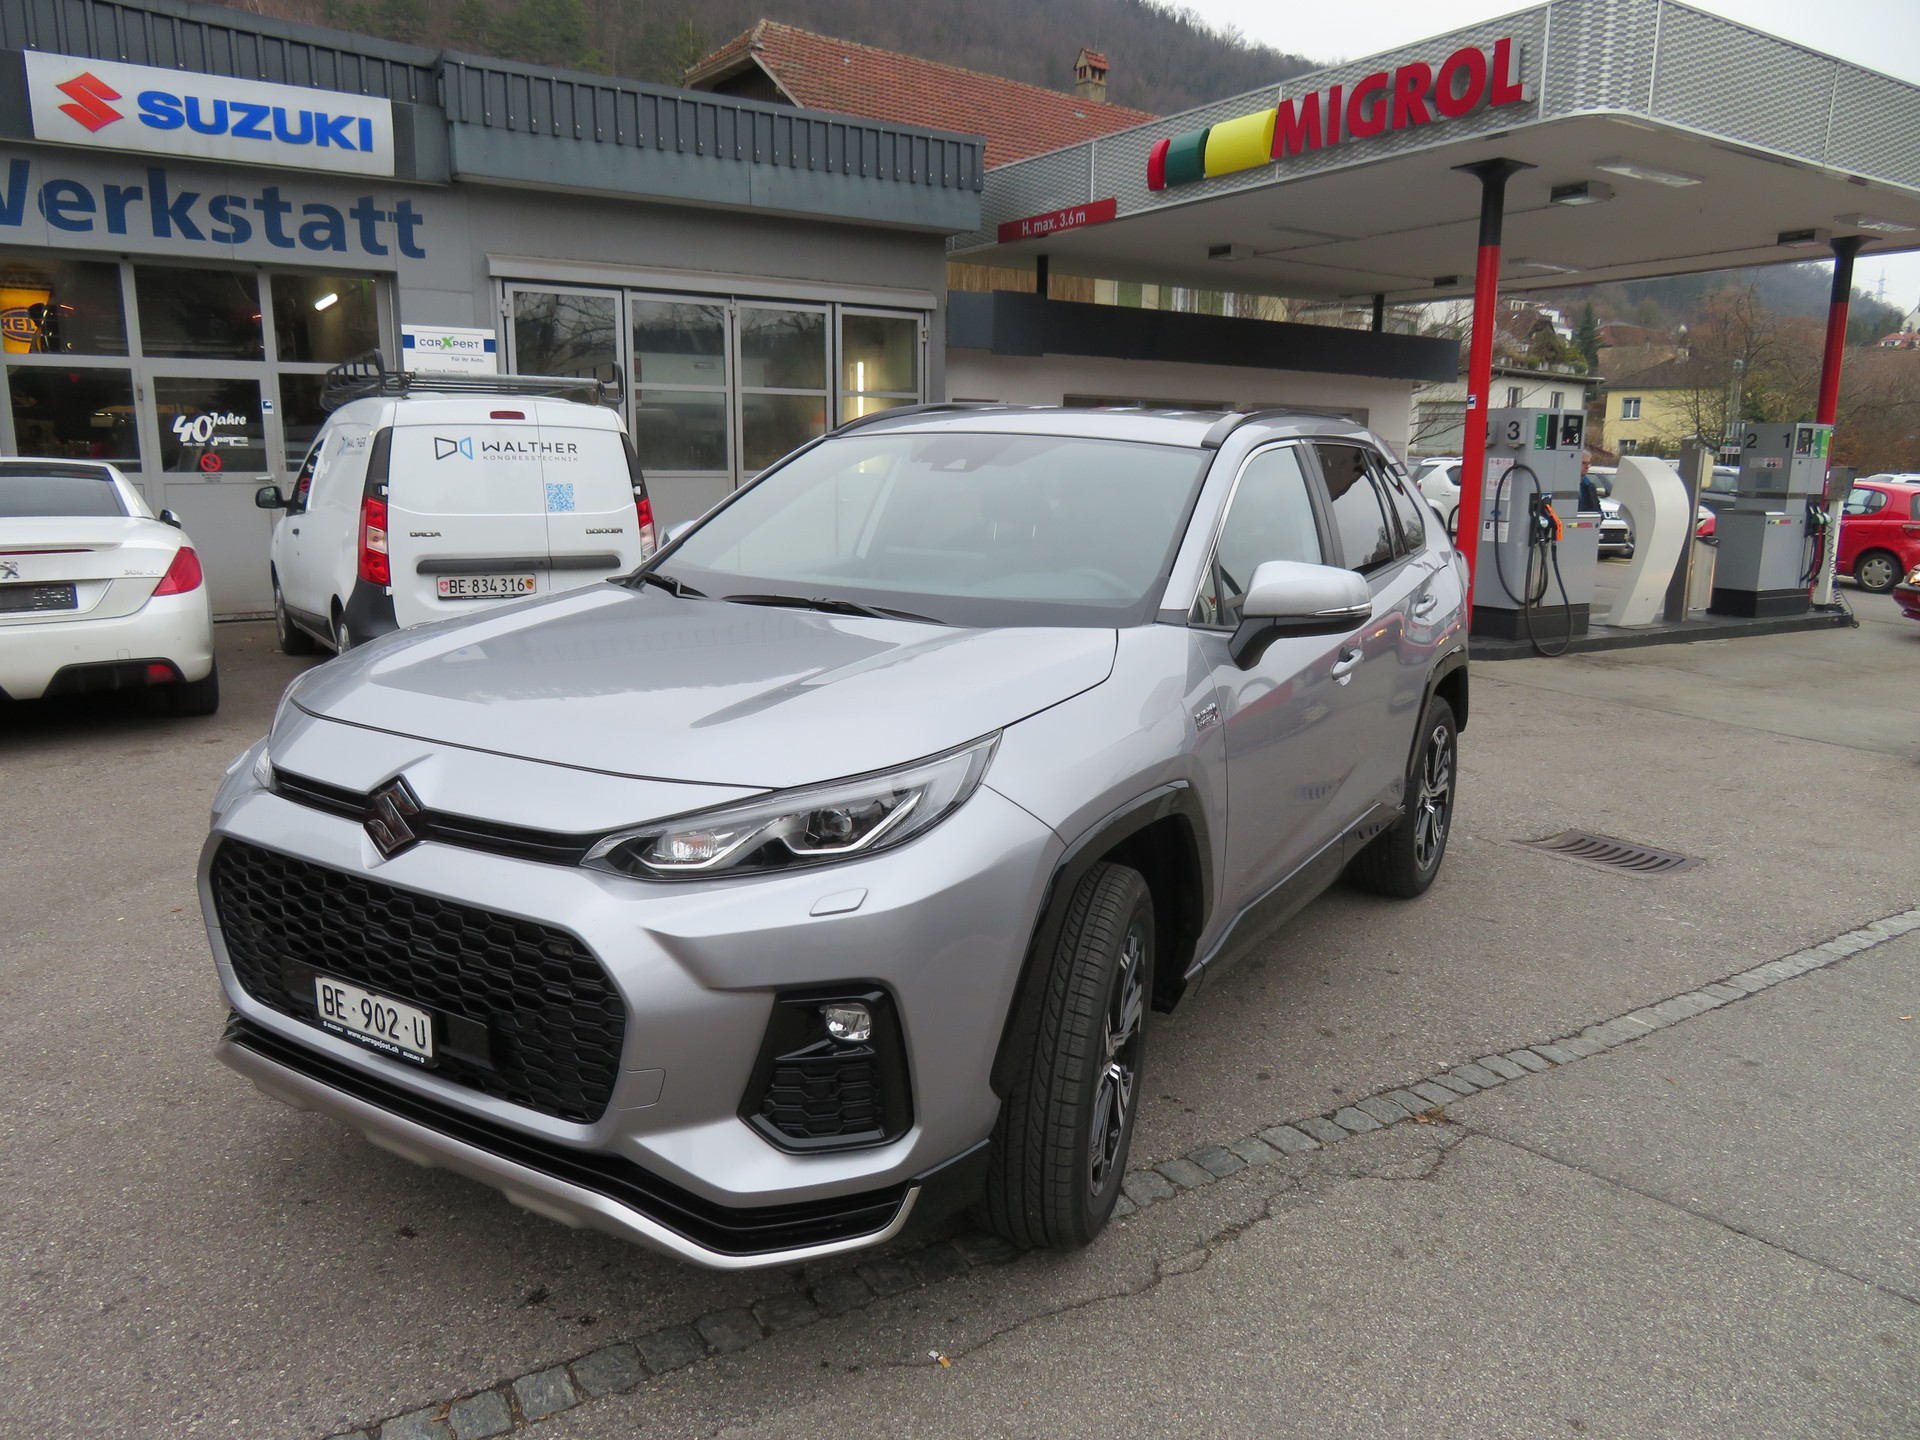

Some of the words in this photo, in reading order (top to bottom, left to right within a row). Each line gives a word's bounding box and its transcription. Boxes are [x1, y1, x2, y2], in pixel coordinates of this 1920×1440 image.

[1271, 37, 1524, 159] MIGROL
[137, 90, 373, 152] SUZUKI
[1033, 218, 1057, 233] max.
[173, 415, 213, 442] 40
[210, 412, 247, 427] Jahre
[1507, 421, 1520, 440] 3
[1573, 433, 1580, 444] 3
[1746, 433, 1758, 449] 2
[1783, 433, 1791, 448] 1
[482, 441, 578, 454] WALTHER
